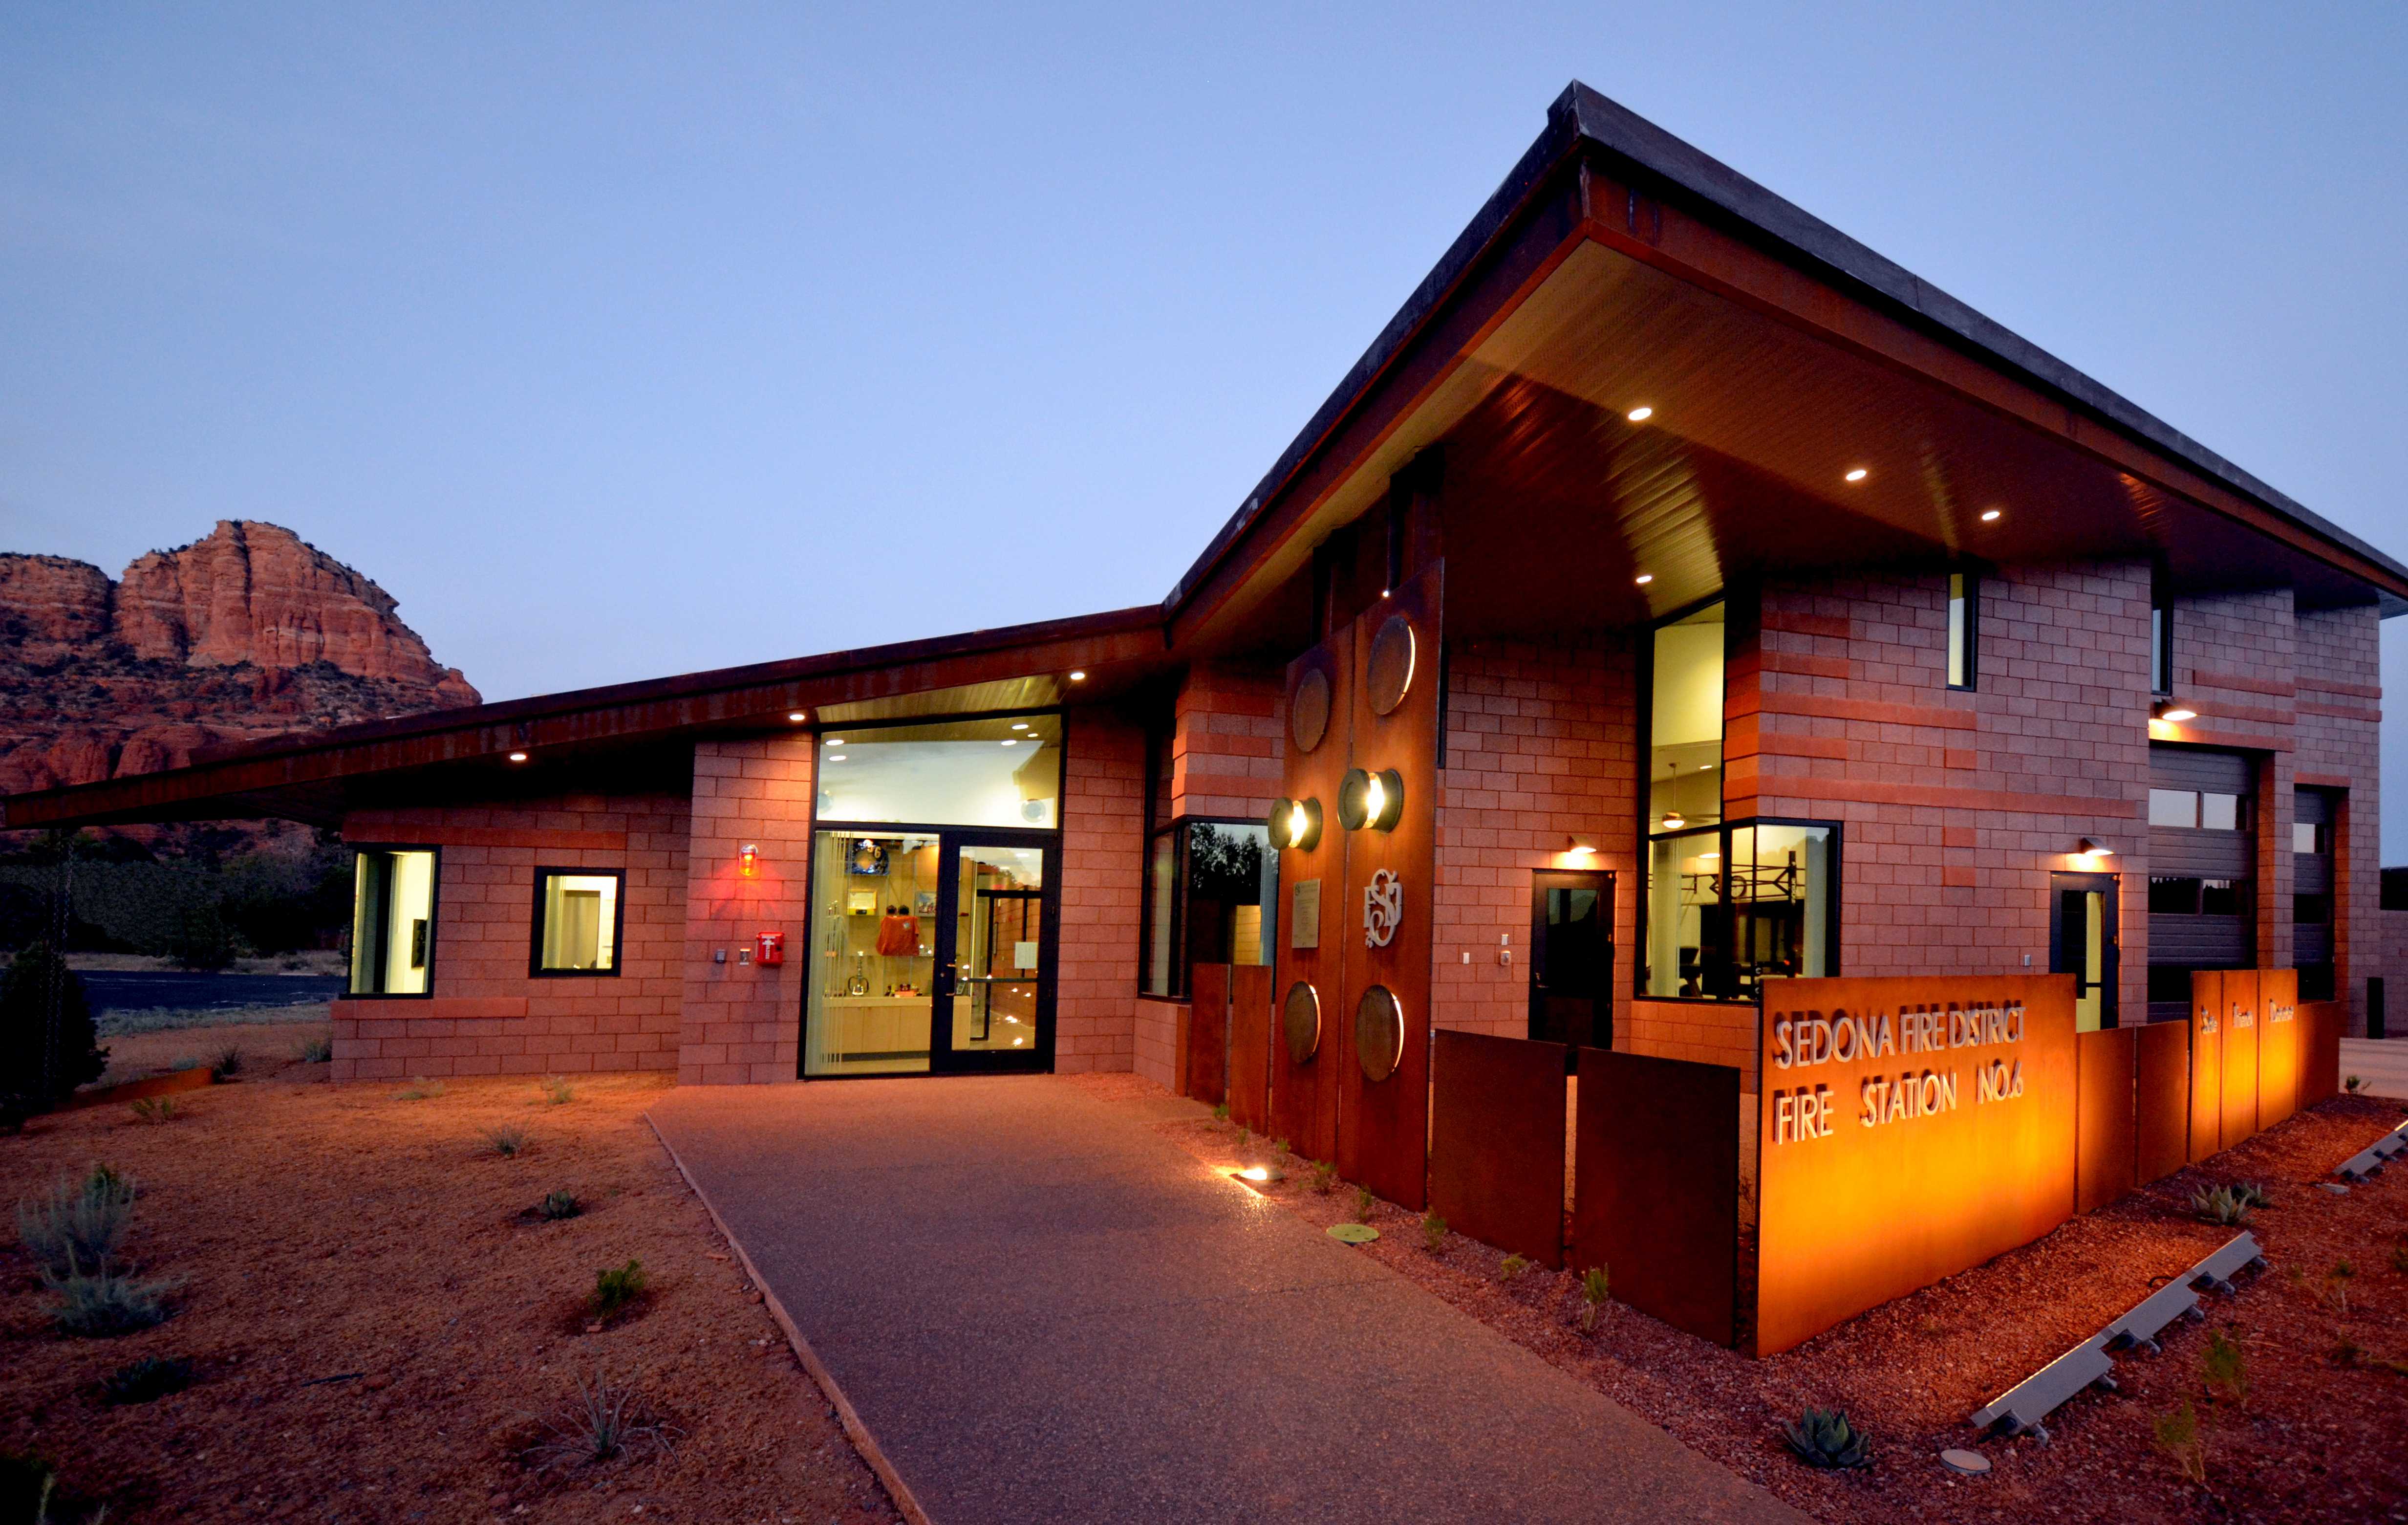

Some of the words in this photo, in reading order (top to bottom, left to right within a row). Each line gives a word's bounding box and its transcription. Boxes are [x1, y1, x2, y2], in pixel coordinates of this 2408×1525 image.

[1775, 1017, 1895, 1069] SEDONA
[1900, 1012, 1945, 1054] FIRE
[1949, 1007, 2026, 1048] DISTRICT
[1775, 1090, 1834, 1145] FIRE
[1861, 1072, 1956, 1128] STATION
